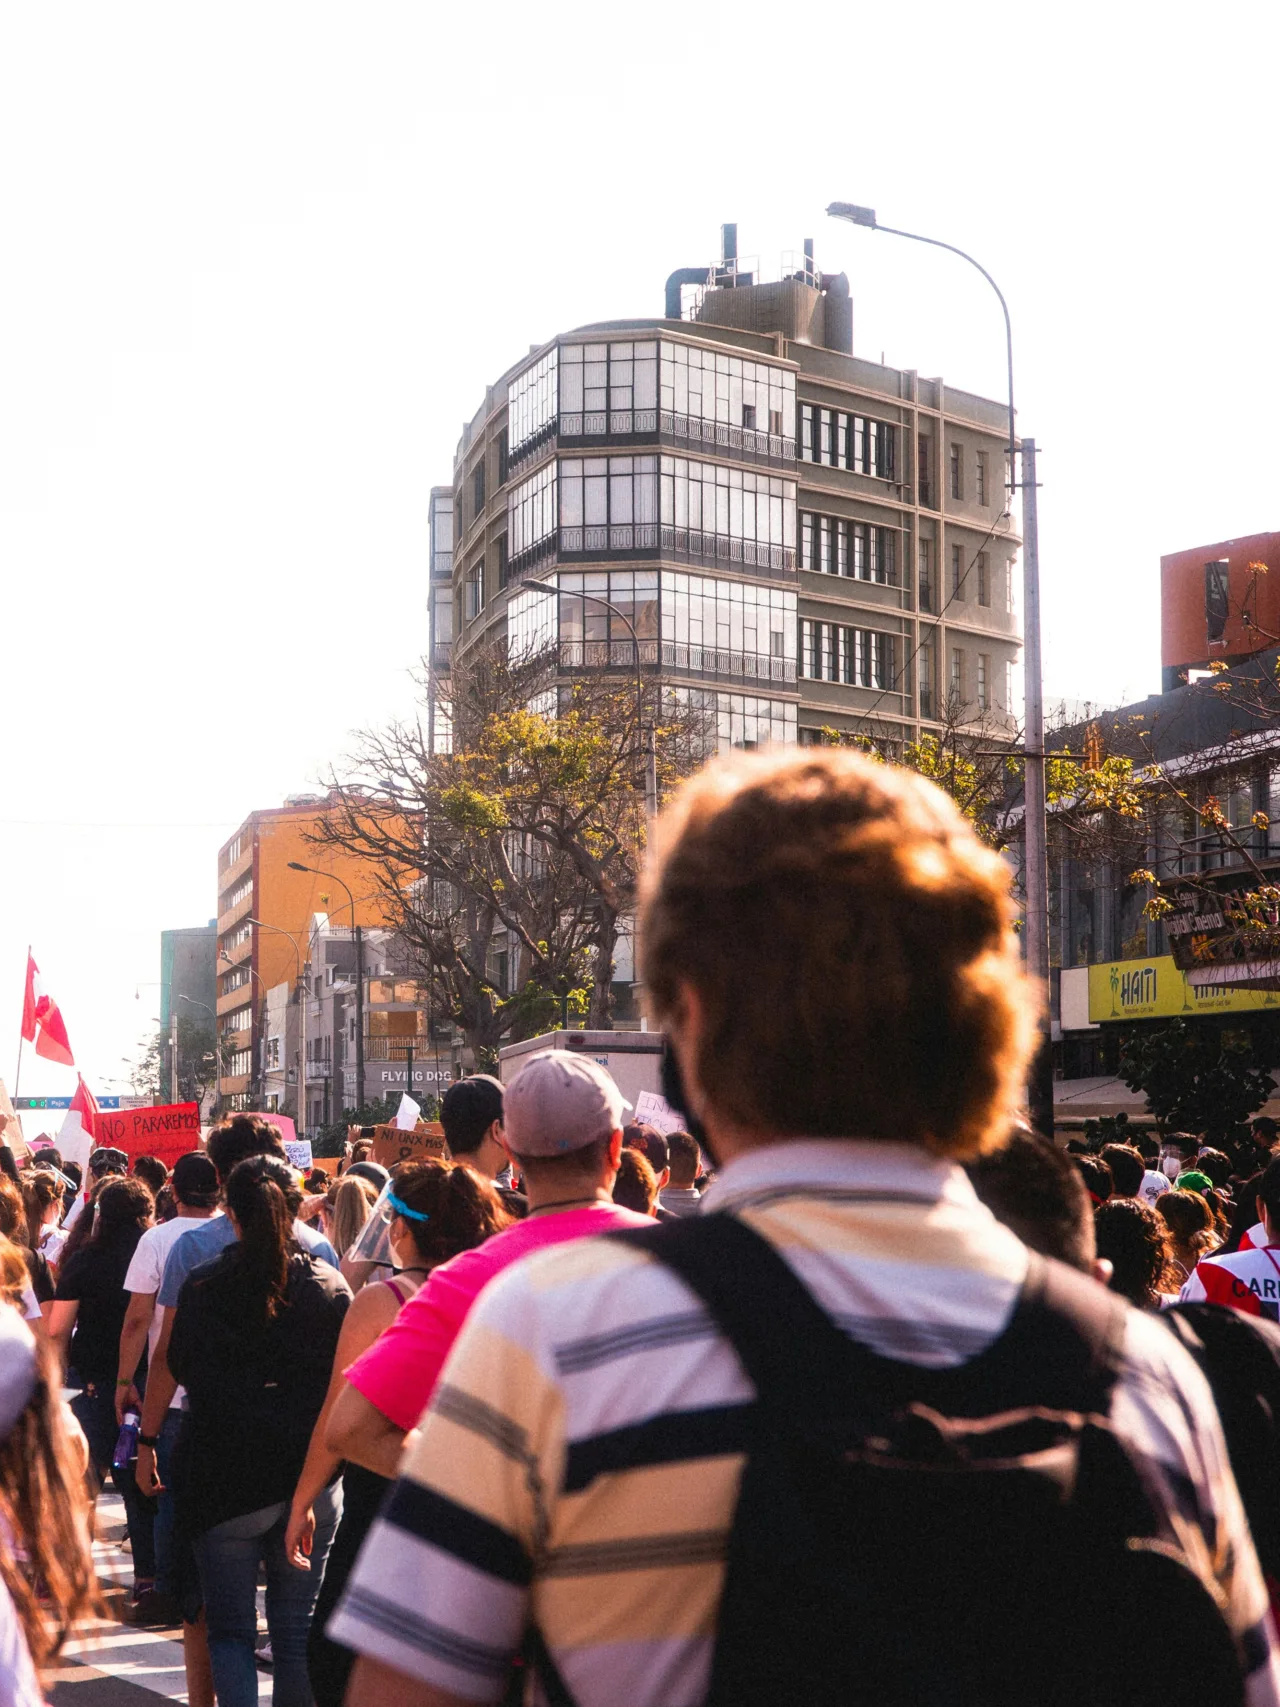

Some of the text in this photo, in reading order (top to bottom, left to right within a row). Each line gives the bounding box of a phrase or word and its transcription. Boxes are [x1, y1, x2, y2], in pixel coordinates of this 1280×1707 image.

[1188, 911, 1223, 932] Cinema
[1120, 966, 1157, 1006] HAITI
[426, 1070, 452, 1082] DOG
[101, 1111, 199, 1143] NO PARAREMOS
[380, 1129, 395, 1141] NI
[1231, 1276, 1280, 1300] CAR
